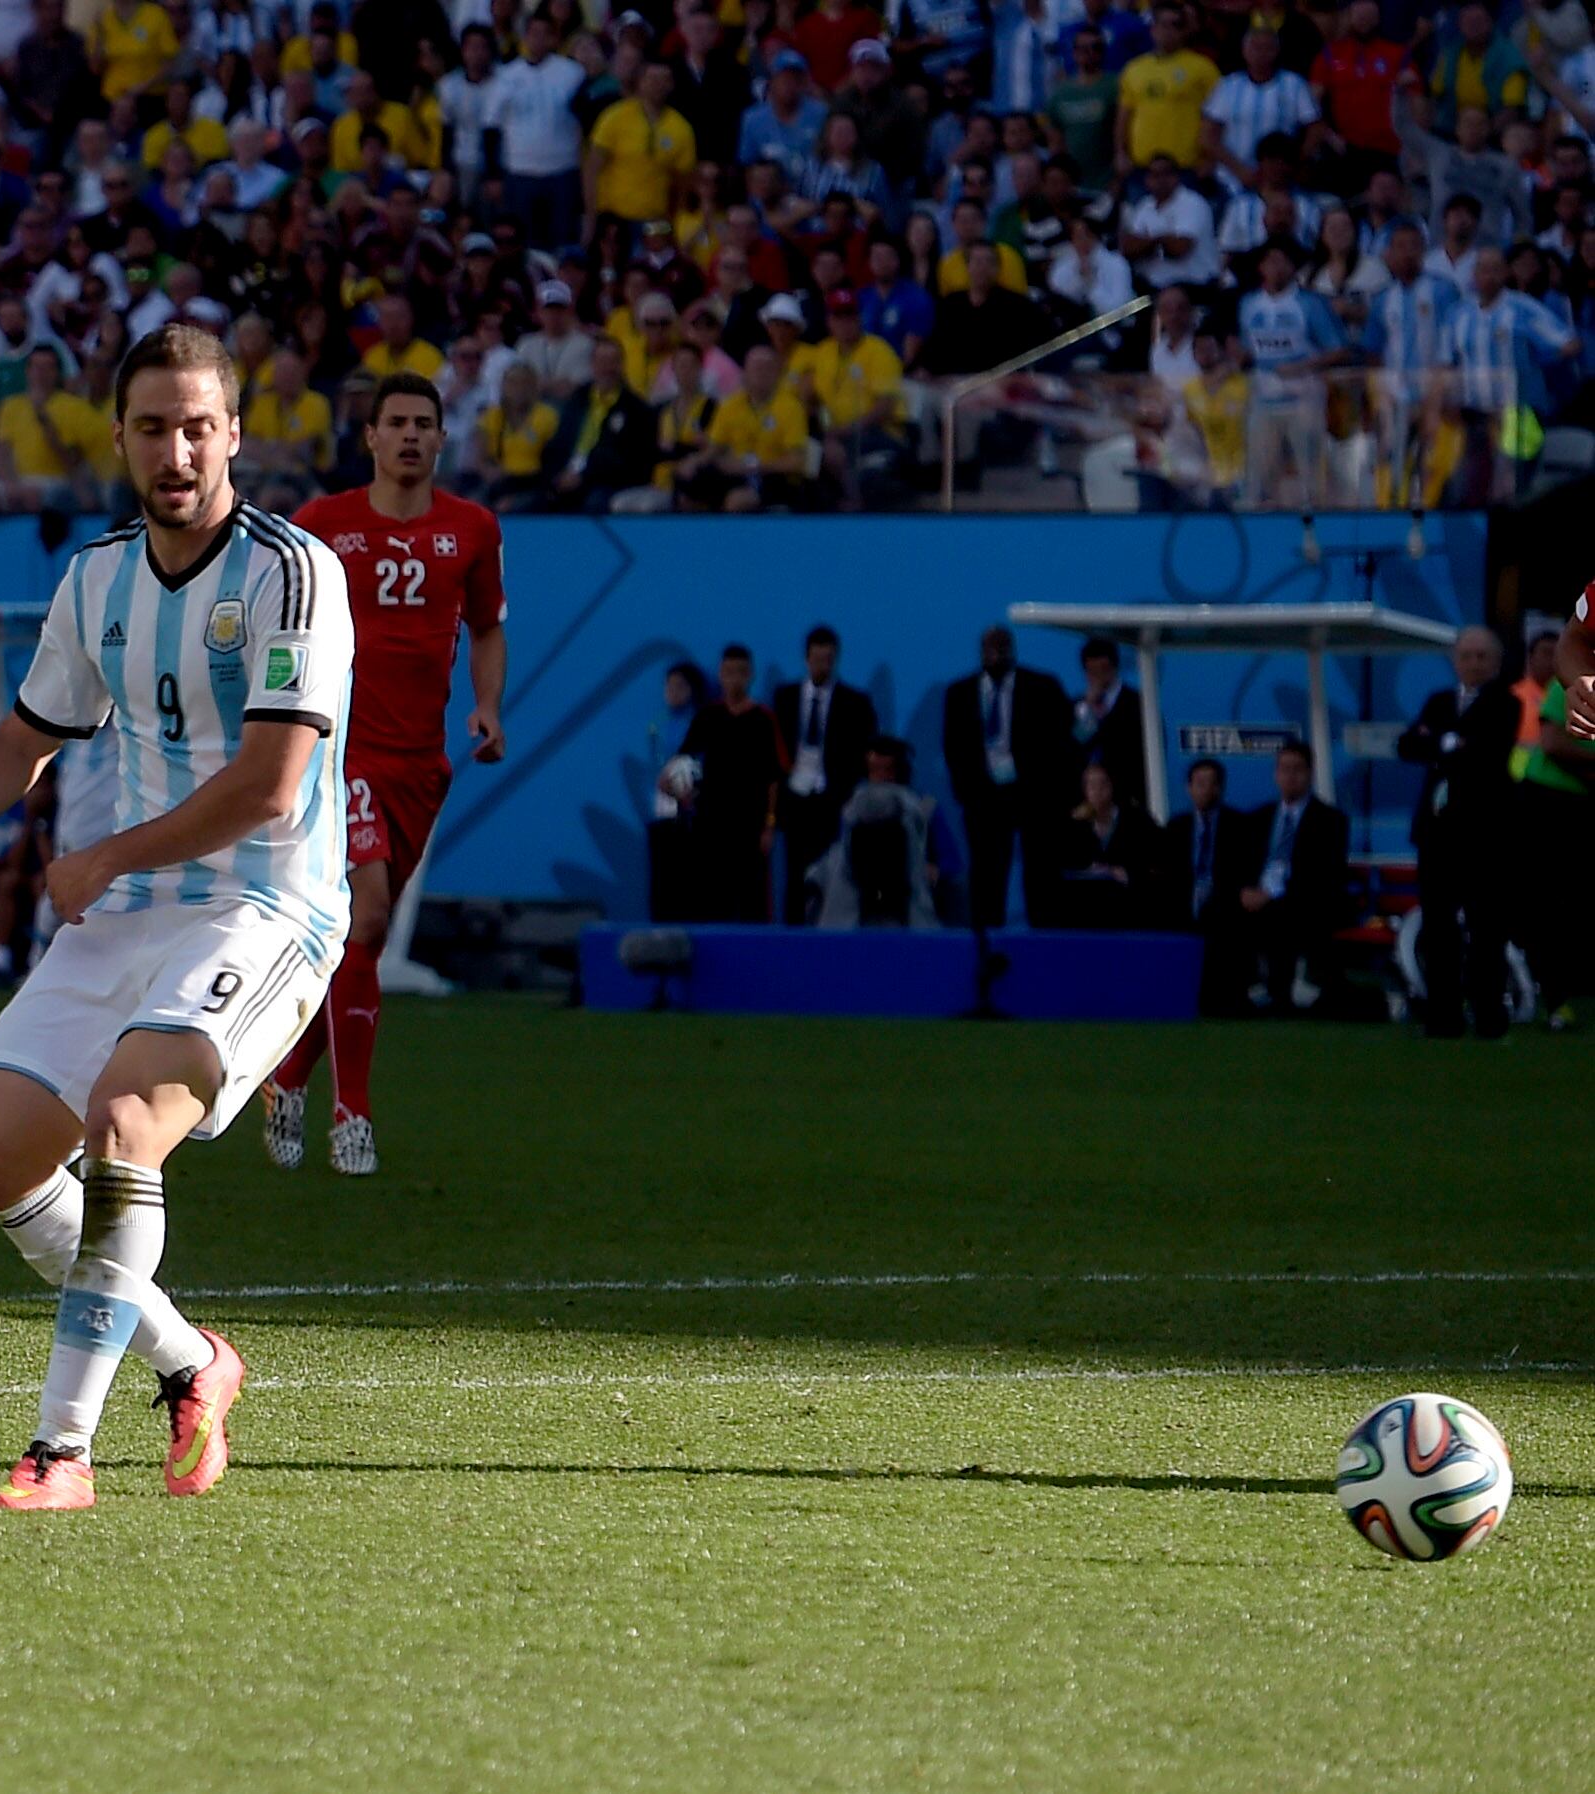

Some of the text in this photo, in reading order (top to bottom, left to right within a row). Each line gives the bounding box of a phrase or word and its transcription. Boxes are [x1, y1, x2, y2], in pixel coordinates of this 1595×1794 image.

[375, 558, 426, 606] 22
[157, 672, 184, 742] 9
[201, 971, 243, 1014] 9
